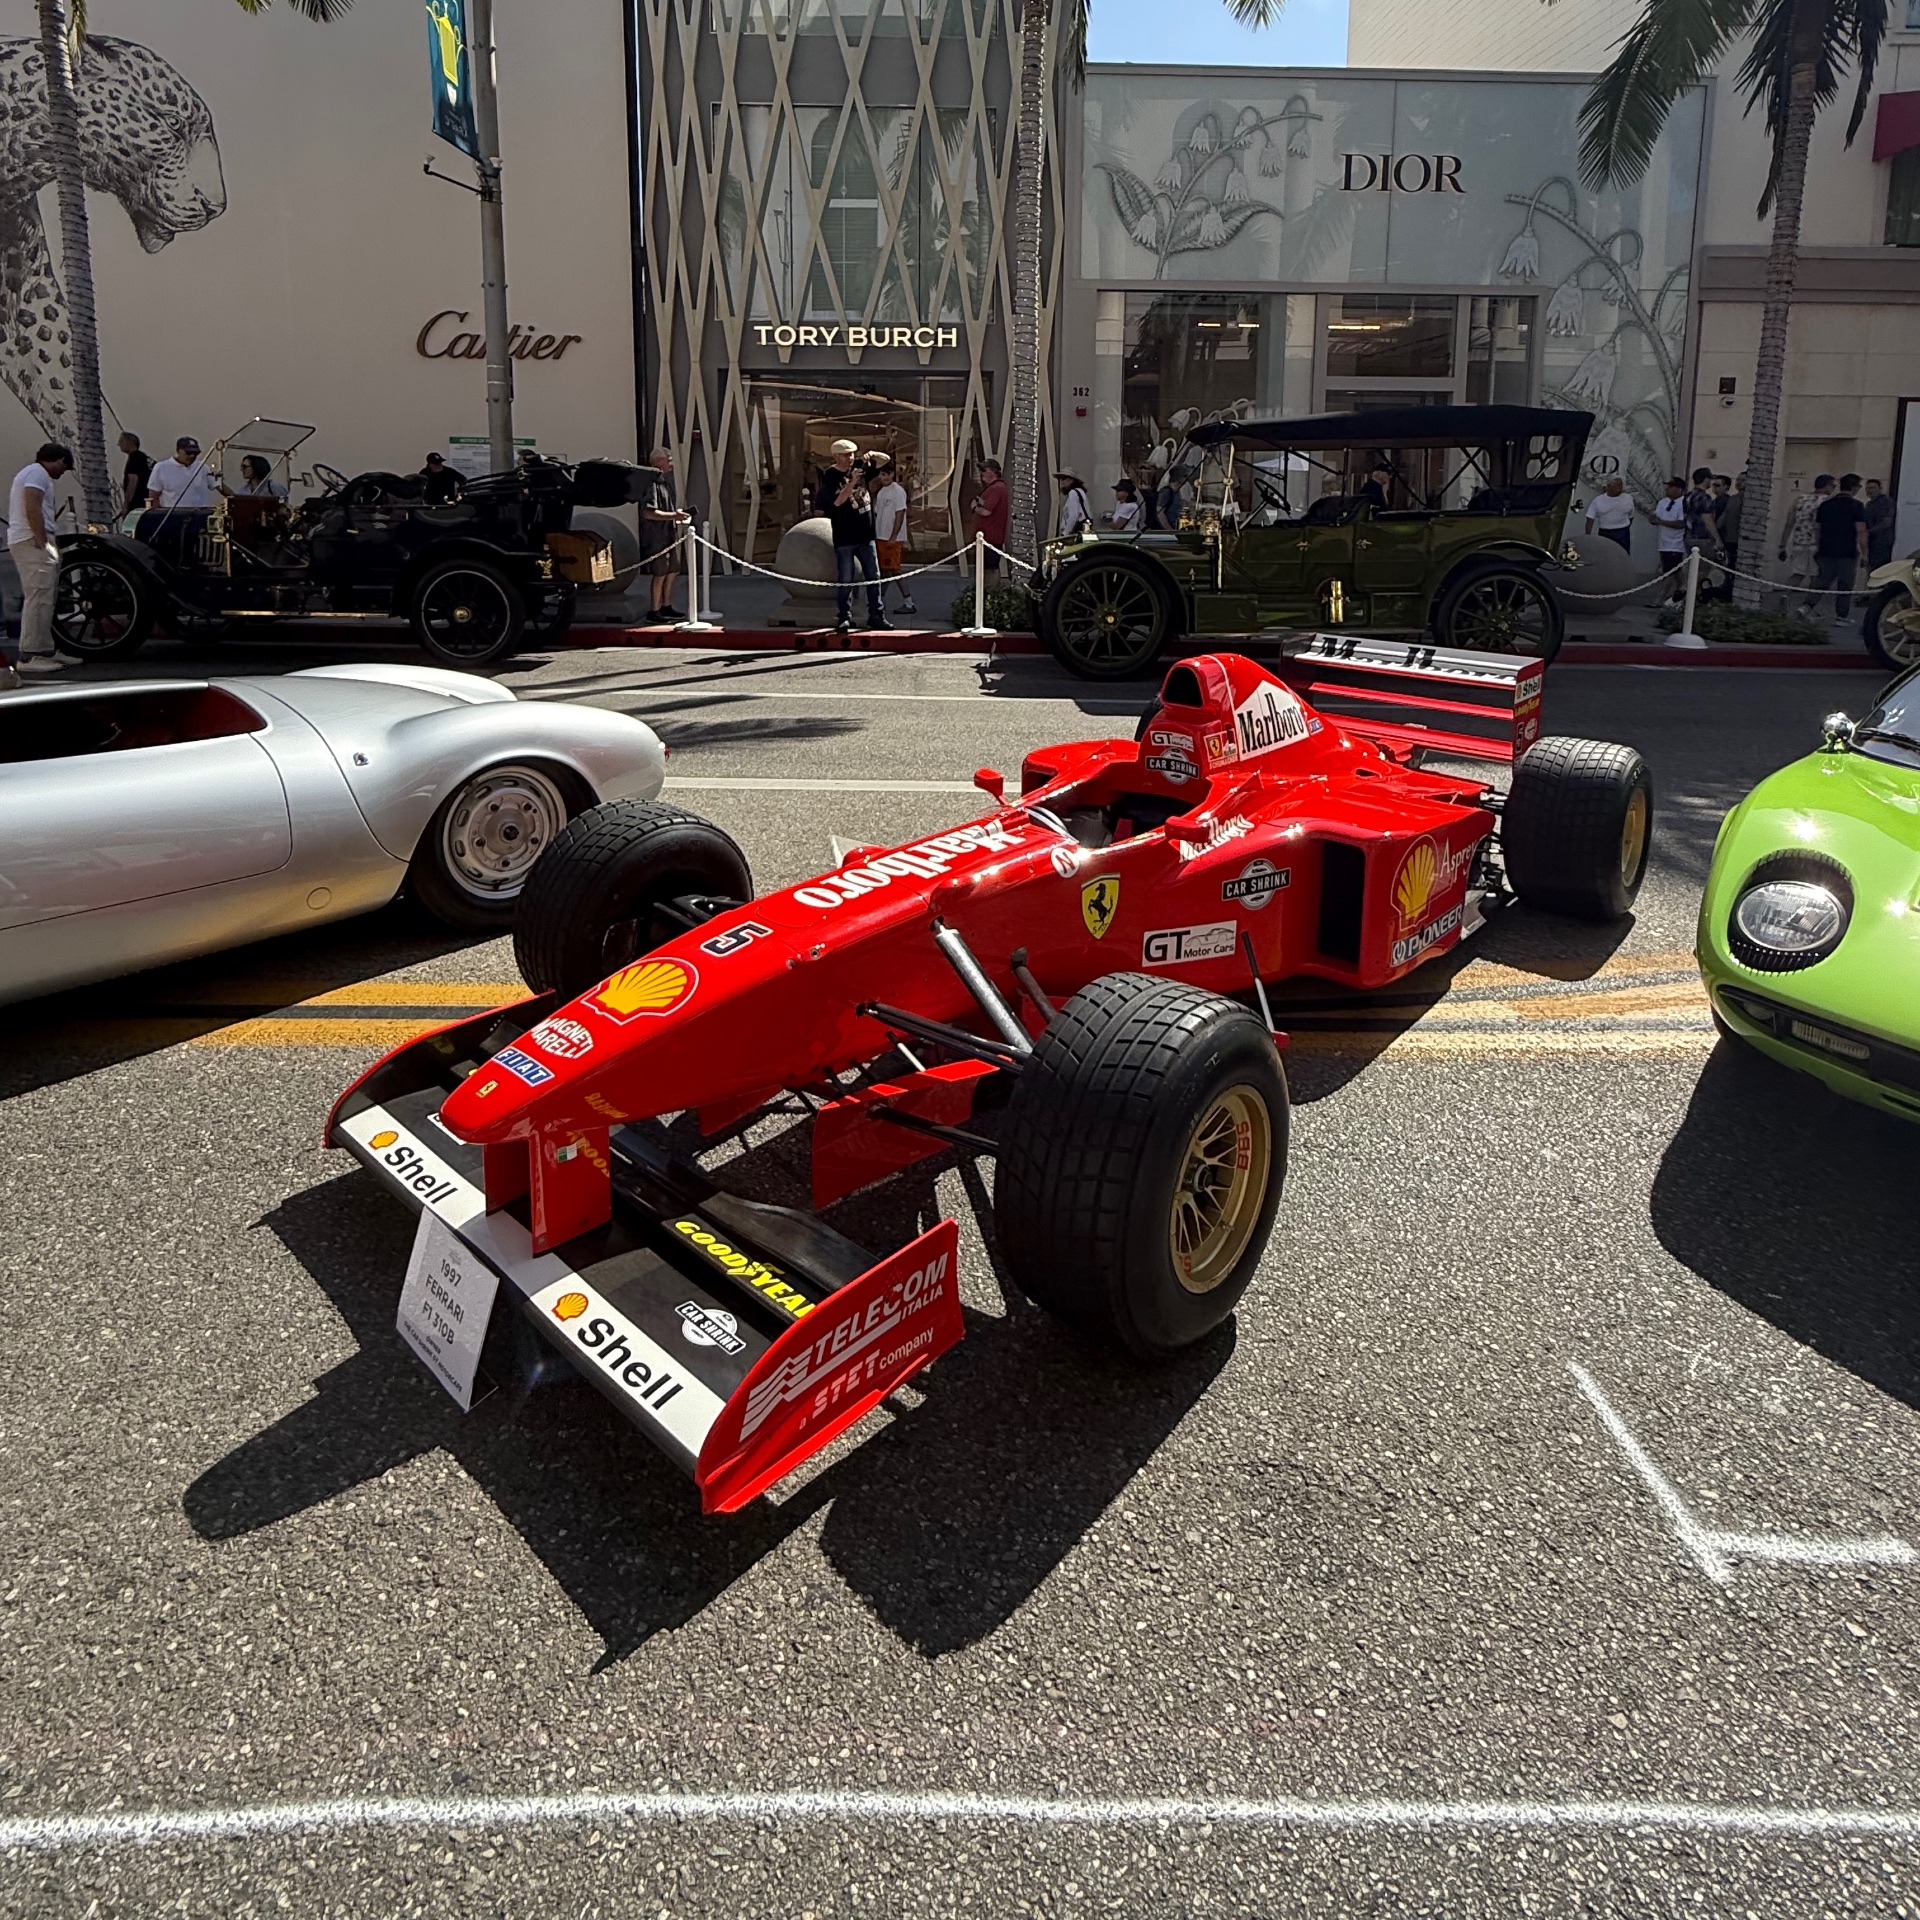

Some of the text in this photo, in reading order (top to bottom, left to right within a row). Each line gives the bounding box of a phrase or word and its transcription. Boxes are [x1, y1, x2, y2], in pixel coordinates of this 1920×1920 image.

[1339, 153, 1466, 193] DIOR
[417, 310, 582, 360] Catier
[754, 326, 957, 348] TORY BURCH
[1072, 387, 1090, 397] 362
[1152, 732, 1173, 744] GT
[1237, 692, 1305, 755] Marlboro
[1149, 759, 1197, 776] CAR SHRINK
[793, 818, 1026, 908] Marlboro
[1226, 871, 1287, 897] CAR SHRINK
[700, 921, 774, 957] 5
[1144, 930, 1191, 962] GT
[1183, 943, 1234, 959] Motor Cars
[531, 1030, 594, 1059] MARELLI
[533, 1017, 594, 1048] MAGNETI
[496, 1049, 549, 1083] FIAT
[1236, 1121, 1250, 1170] BBS
[384, 1146, 459, 1205] Shell
[440, 1258, 462, 1288] 1997
[425, 1273, 465, 1324] FERRARI
[901, 1284, 943, 1321] ITALIA
[421, 1300, 455, 1345] F1 310B
[681, 1305, 705, 1323] CAR
[700, 1320, 739, 1351] SHRINK
[426, 1335, 442, 1354] OWNER
[577, 1318, 684, 1411] Shell
[812, 1349, 880, 1420] STET
[879, 1326, 934, 1370] company
